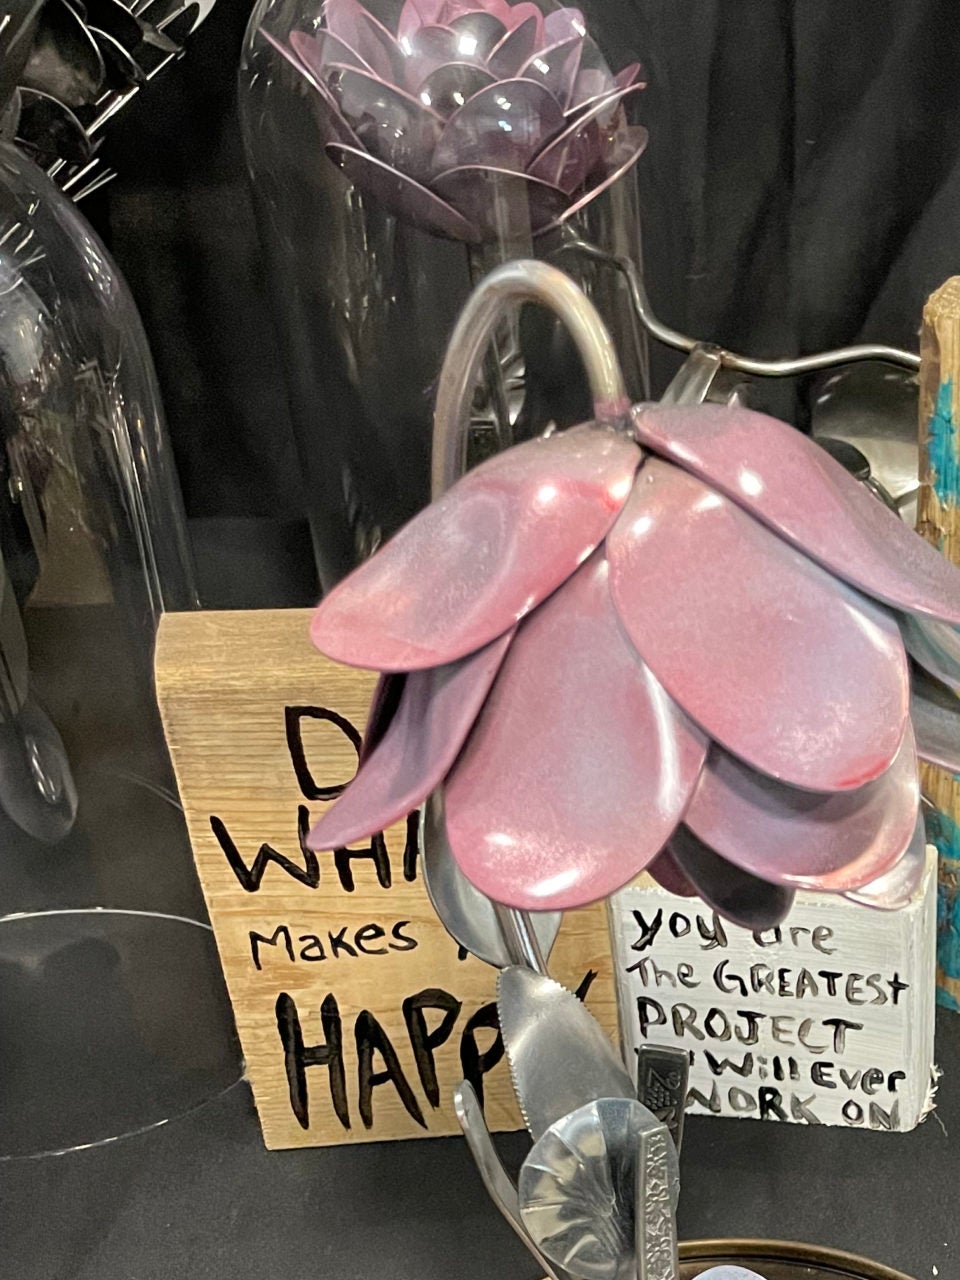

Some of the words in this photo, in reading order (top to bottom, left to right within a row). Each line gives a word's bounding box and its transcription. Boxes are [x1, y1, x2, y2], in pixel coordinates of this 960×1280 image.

[248, 920, 418, 970] Makes
[626, 956, 701, 988] The
[636, 996, 864, 1054] PROJECT
[274, 970, 598, 1130] HAPP
[811, 1061, 906, 1095] Ever
[842, 1099, 900, 1130] ON
